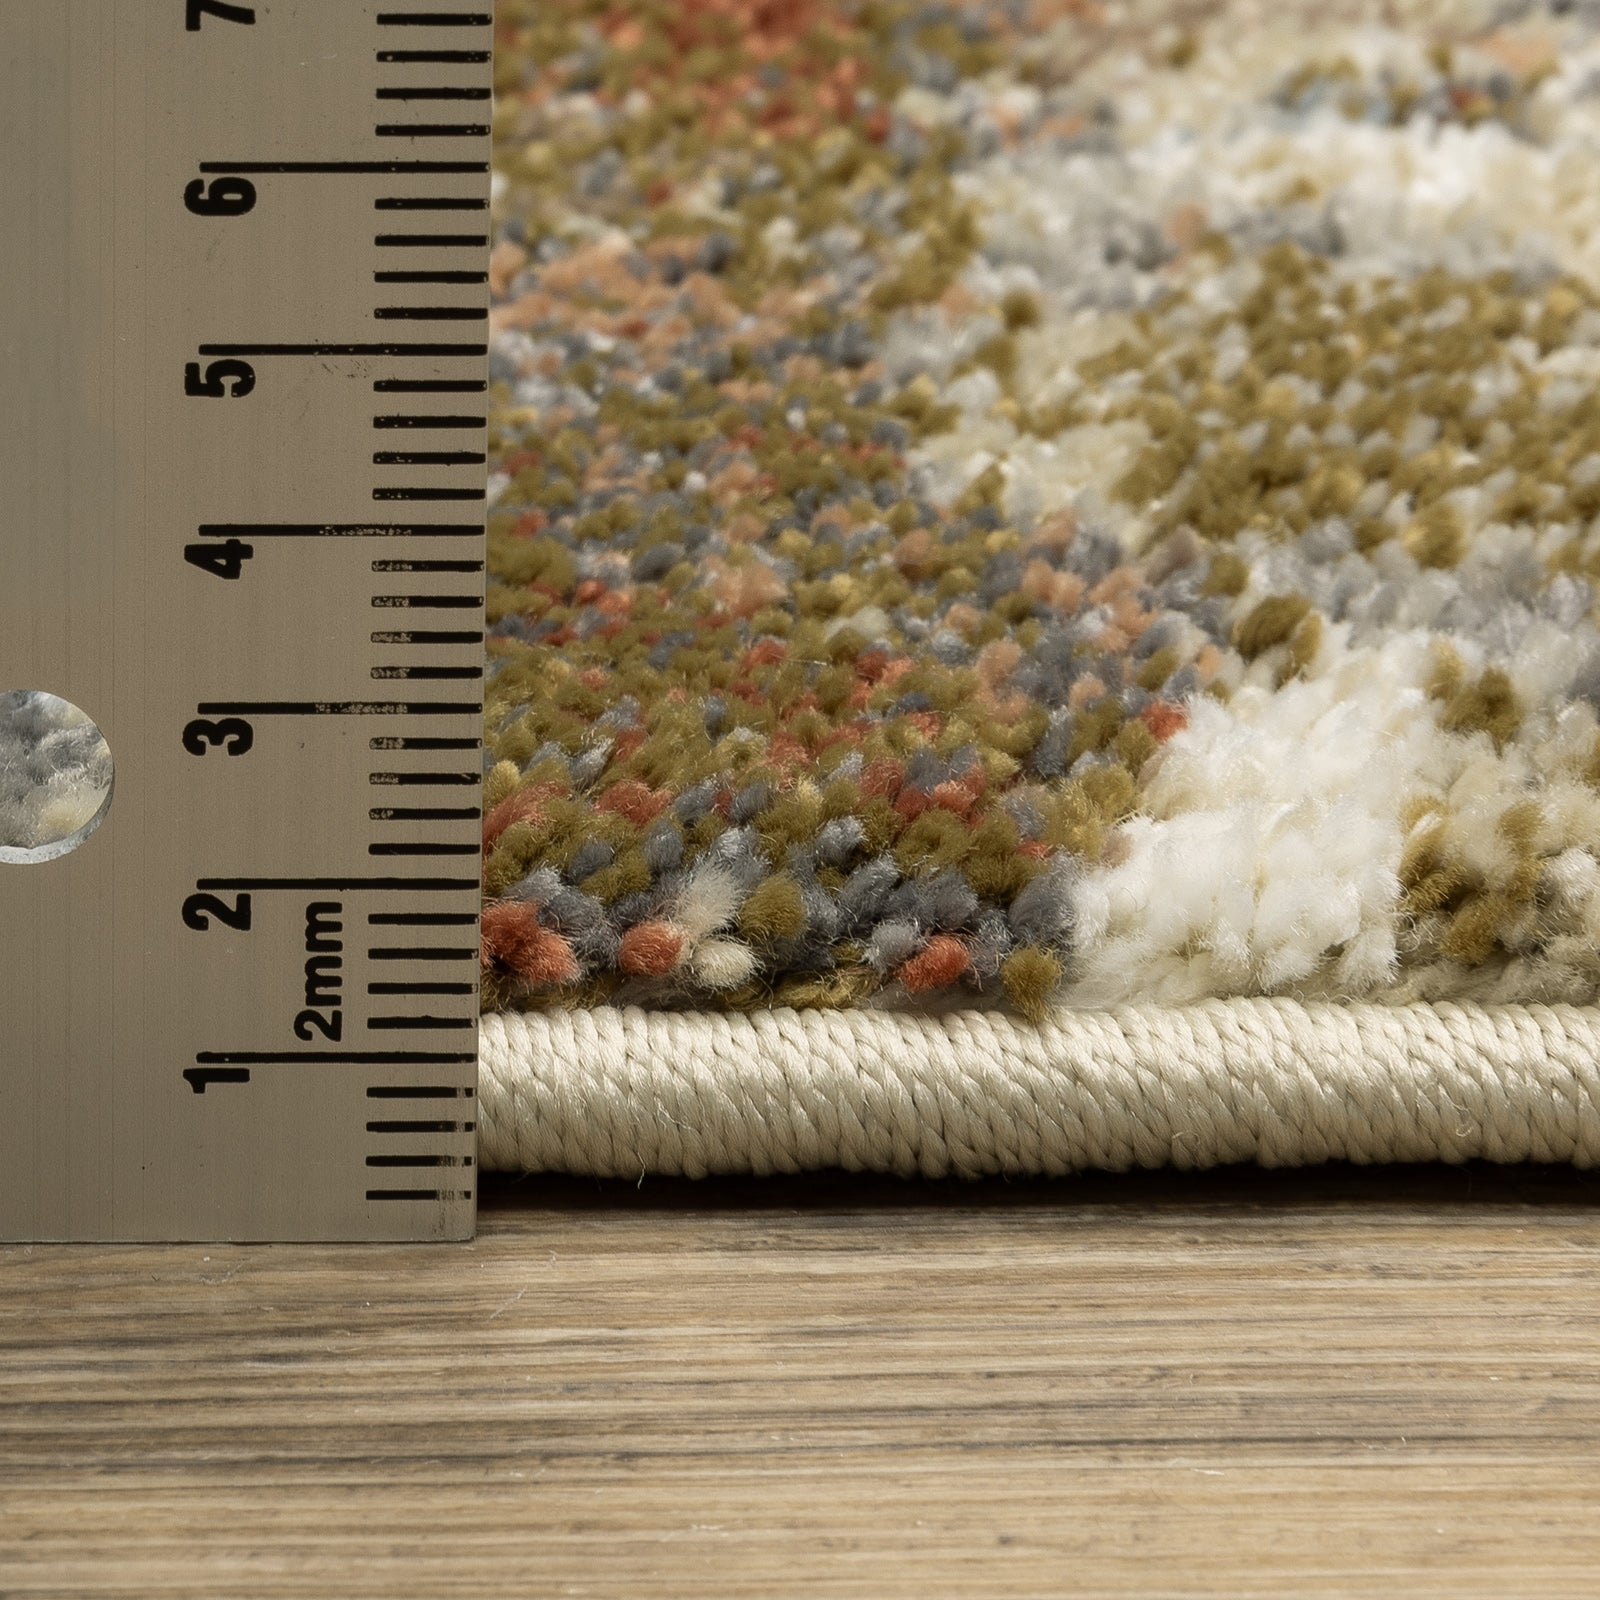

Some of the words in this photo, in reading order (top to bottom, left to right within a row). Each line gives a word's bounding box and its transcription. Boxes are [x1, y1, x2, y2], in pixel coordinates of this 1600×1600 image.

[183, 176, 257, 217] 6
[184, 358, 256, 398] 5
[183, 538, 254, 580] 4
[181, 717, 254, 757] 3
[181, 892, 252, 932] 2
[293, 901, 343, 1043] 2mm
[182, 1067, 251, 1095] 1
